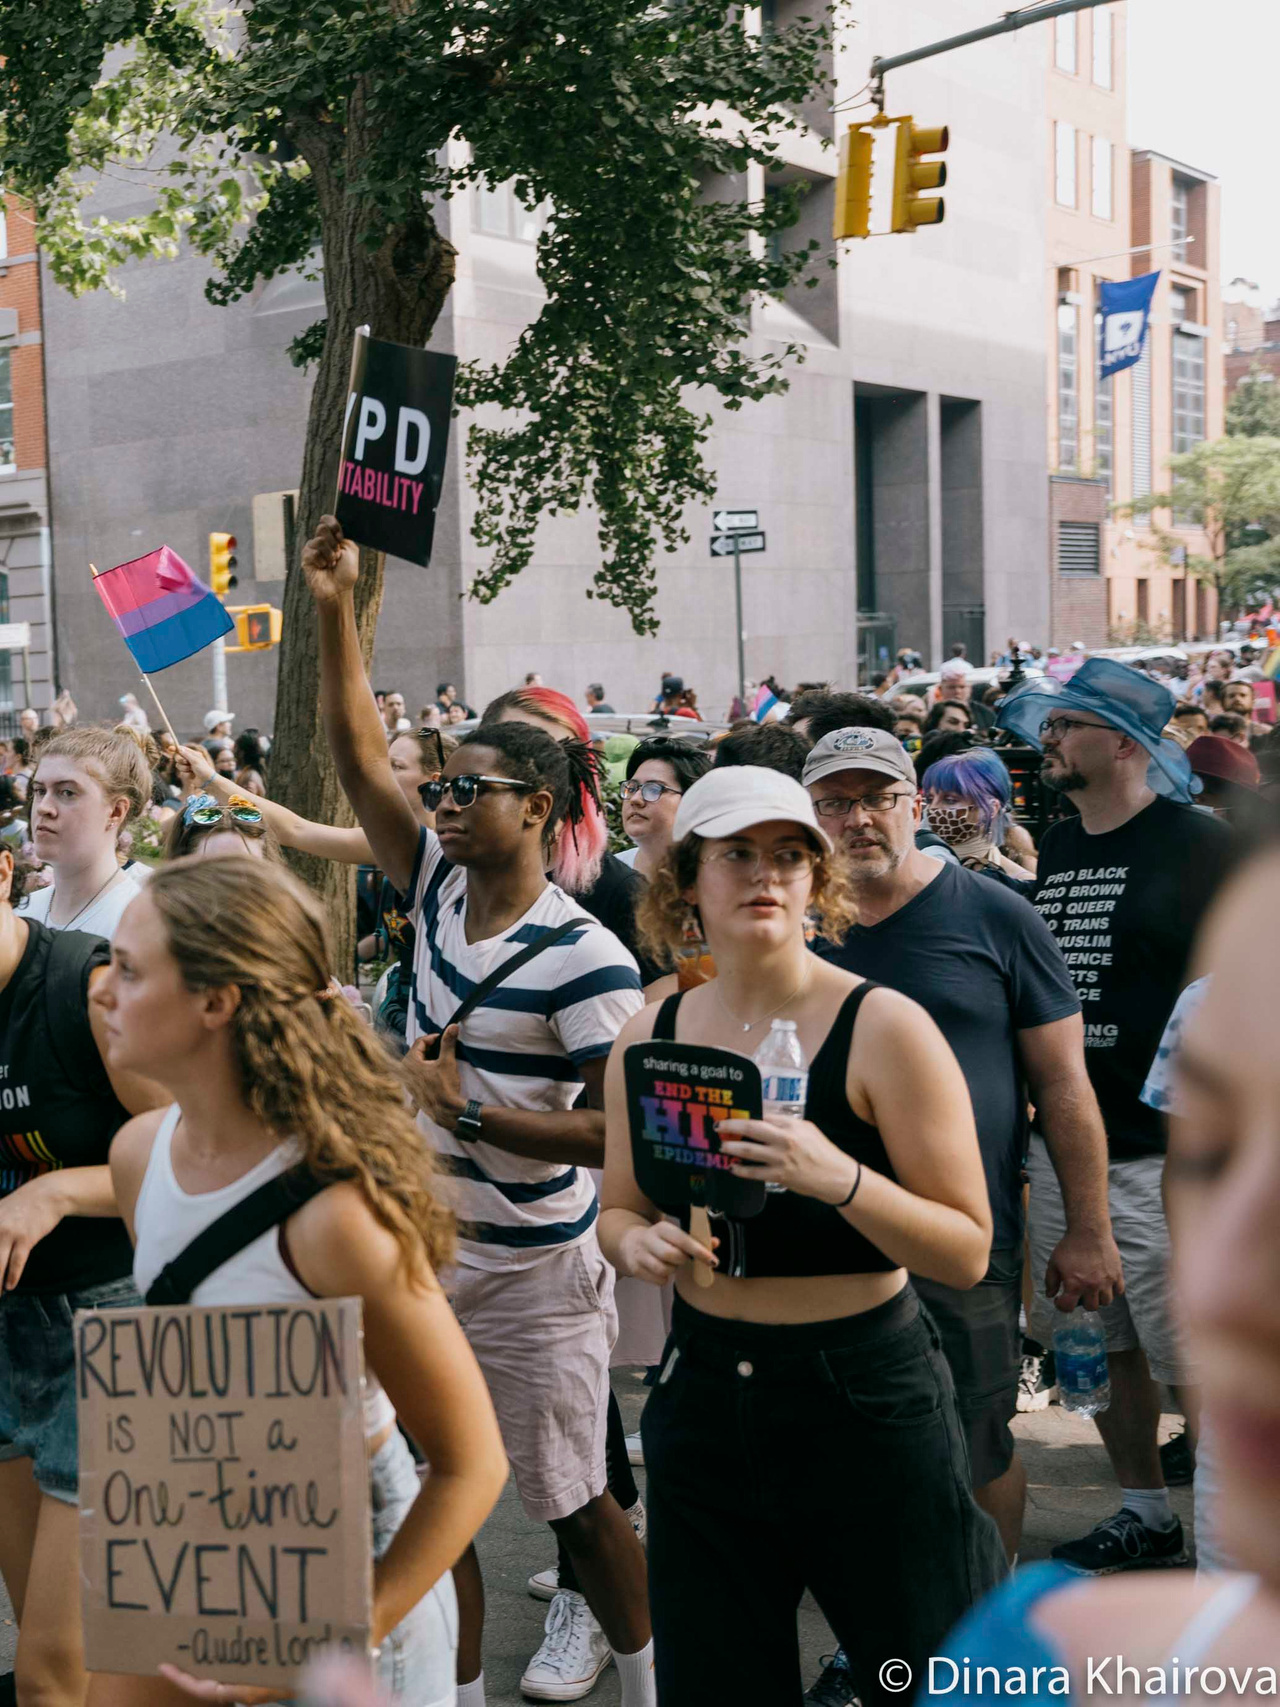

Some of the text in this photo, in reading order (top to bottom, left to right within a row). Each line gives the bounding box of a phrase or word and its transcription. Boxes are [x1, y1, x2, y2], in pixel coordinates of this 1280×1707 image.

[1045, 867, 1129, 886] PRO BLACK
[1035, 883, 1126, 901] PRO BROWN
[1066, 900, 1116, 915] QUEER
[1063, 917, 1109, 931] TRANS
[642, 1056, 744, 1082] sharing a goal to
[653, 1080, 734, 1106] END THE
[79, 1309, 348, 1398] REVOLUTION
[170, 1410, 245, 1455] NOT
[267, 1418, 297, 1451] a
[104, 1460, 339, 1530] One-time
[106, 1538, 328, 1624] EVENT
